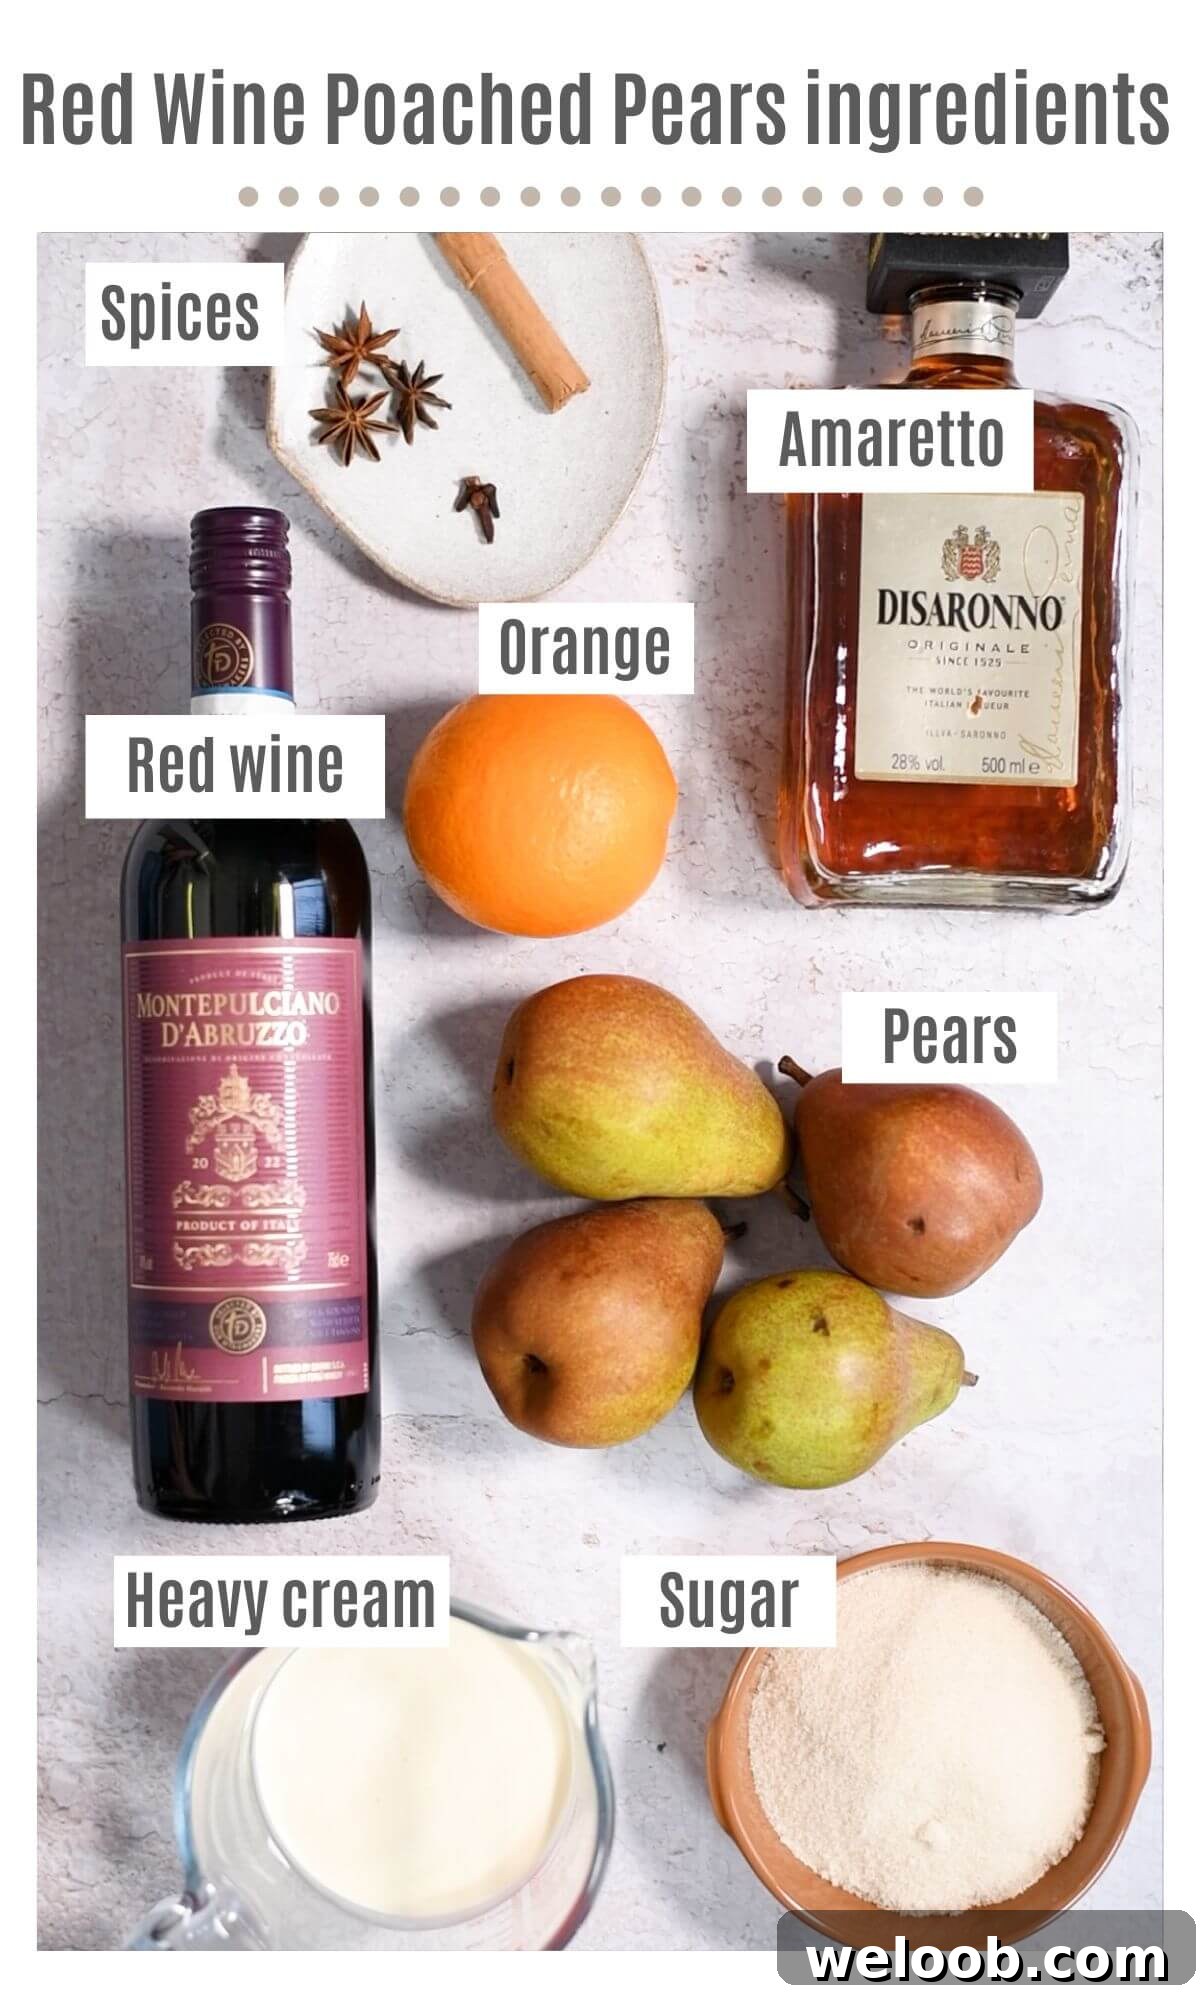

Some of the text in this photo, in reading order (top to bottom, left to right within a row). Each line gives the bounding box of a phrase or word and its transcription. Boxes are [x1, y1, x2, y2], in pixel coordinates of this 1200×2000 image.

[877, 588, 1063, 631] DISARONNO
[907, 640, 1030, 654] ORIGINALE
[936, 656, 968, 666] SINCE
[906, 686, 924, 695] THE
[930, 687, 973, 696] WORLD'S
[925, 699, 962, 709] ITALIAN
[891, 753, 945, 772] 28% vol.
[981, 757, 1006, 774] 500
[136, 991, 341, 1018] MONTEPULCIANO
[161, 1021, 307, 1048] D'ABRUZZO
[192, 1157, 209, 1170] 20
[176, 1220, 235, 1232] PRODUCT
[239, 1220, 259, 1232] OF
